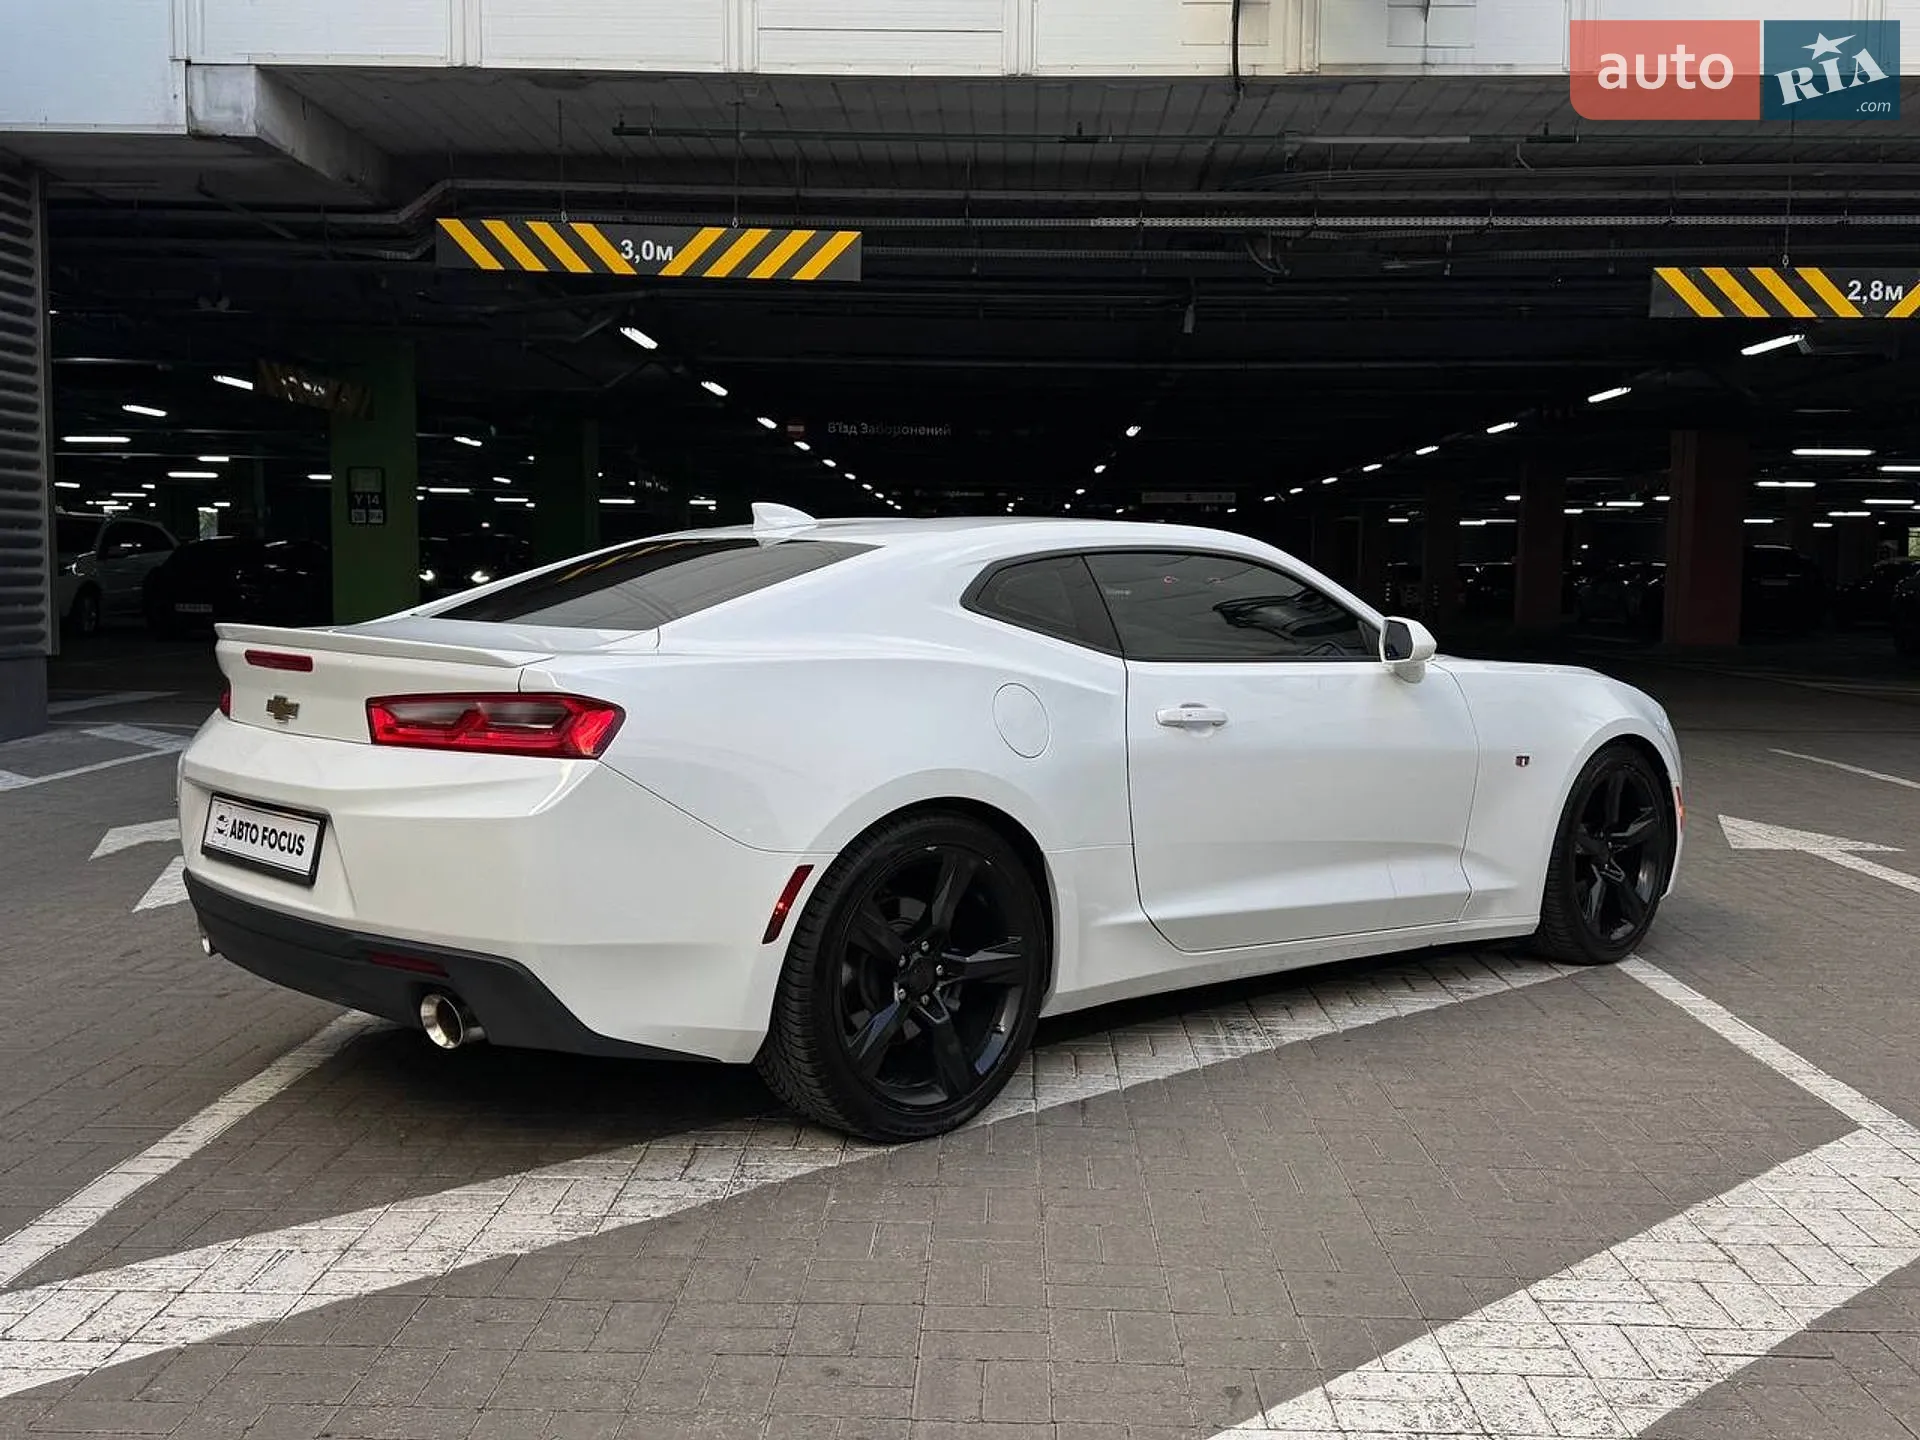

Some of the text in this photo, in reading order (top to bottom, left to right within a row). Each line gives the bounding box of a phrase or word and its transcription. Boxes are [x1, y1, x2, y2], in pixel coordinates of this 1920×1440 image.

[620, 239, 673, 264] 3,0м
[1847, 280, 1904, 305] 2,8м
[261, 826, 305, 856] FOCUS
